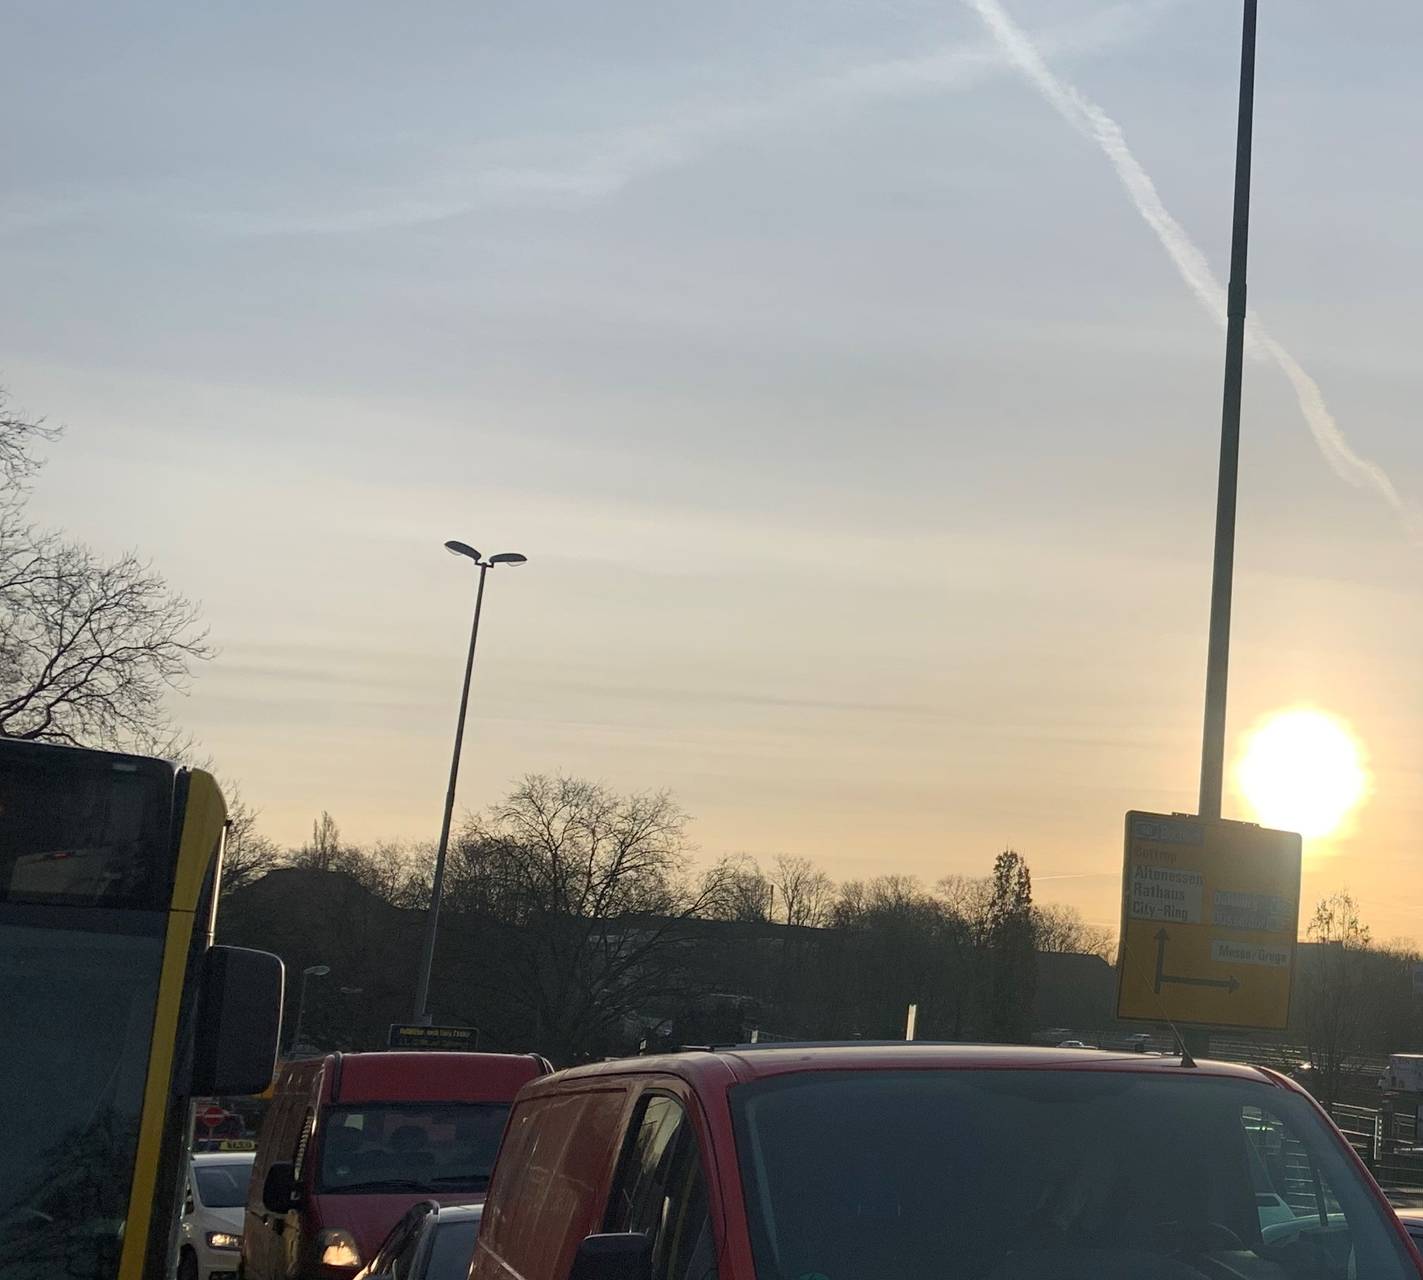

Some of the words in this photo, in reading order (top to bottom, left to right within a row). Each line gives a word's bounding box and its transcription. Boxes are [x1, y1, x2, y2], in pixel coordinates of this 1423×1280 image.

[1135, 864, 1204, 885] Altenessen
[1133, 882, 1185, 900] Rathaus
[1132, 901, 1188, 922] City-Ring
